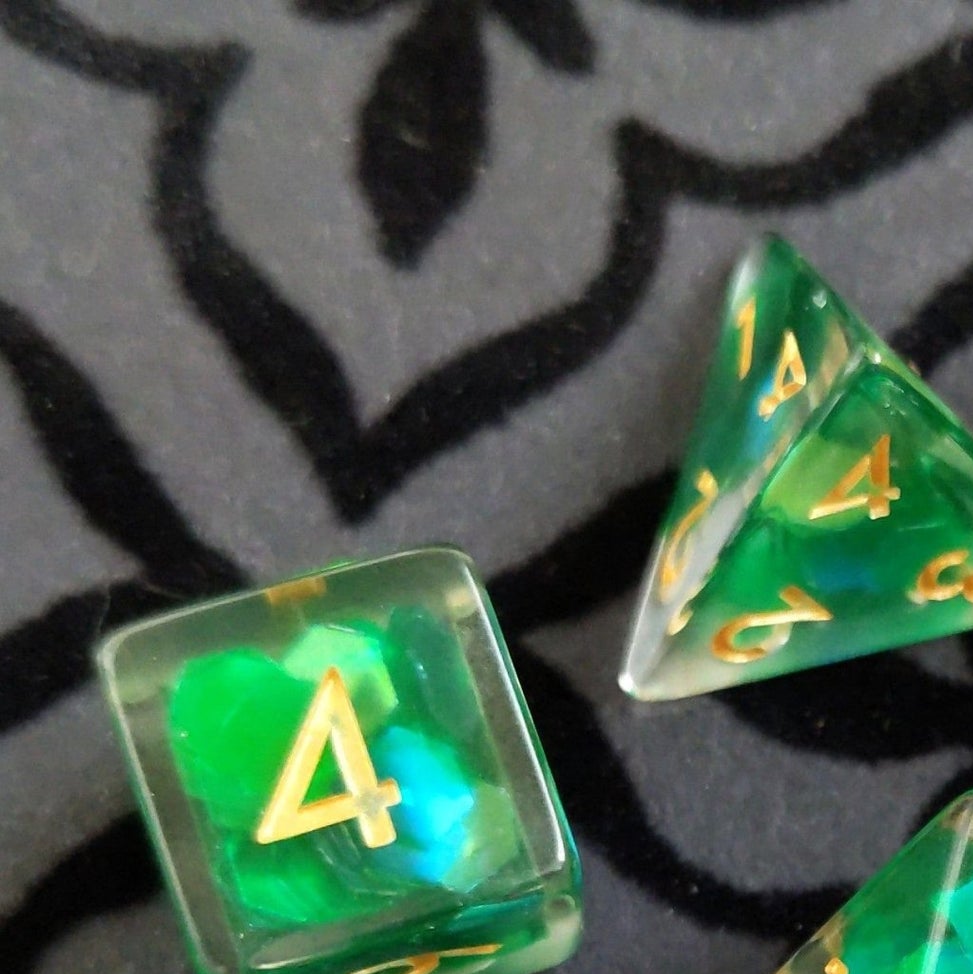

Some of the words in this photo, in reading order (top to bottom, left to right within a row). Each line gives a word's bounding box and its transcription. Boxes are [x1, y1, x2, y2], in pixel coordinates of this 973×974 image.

[734, 297, 756, 380] 1
[757, 329, 807, 421] 4
[808, 434, 901, 521] 4
[254, 666, 402, 849] 4
